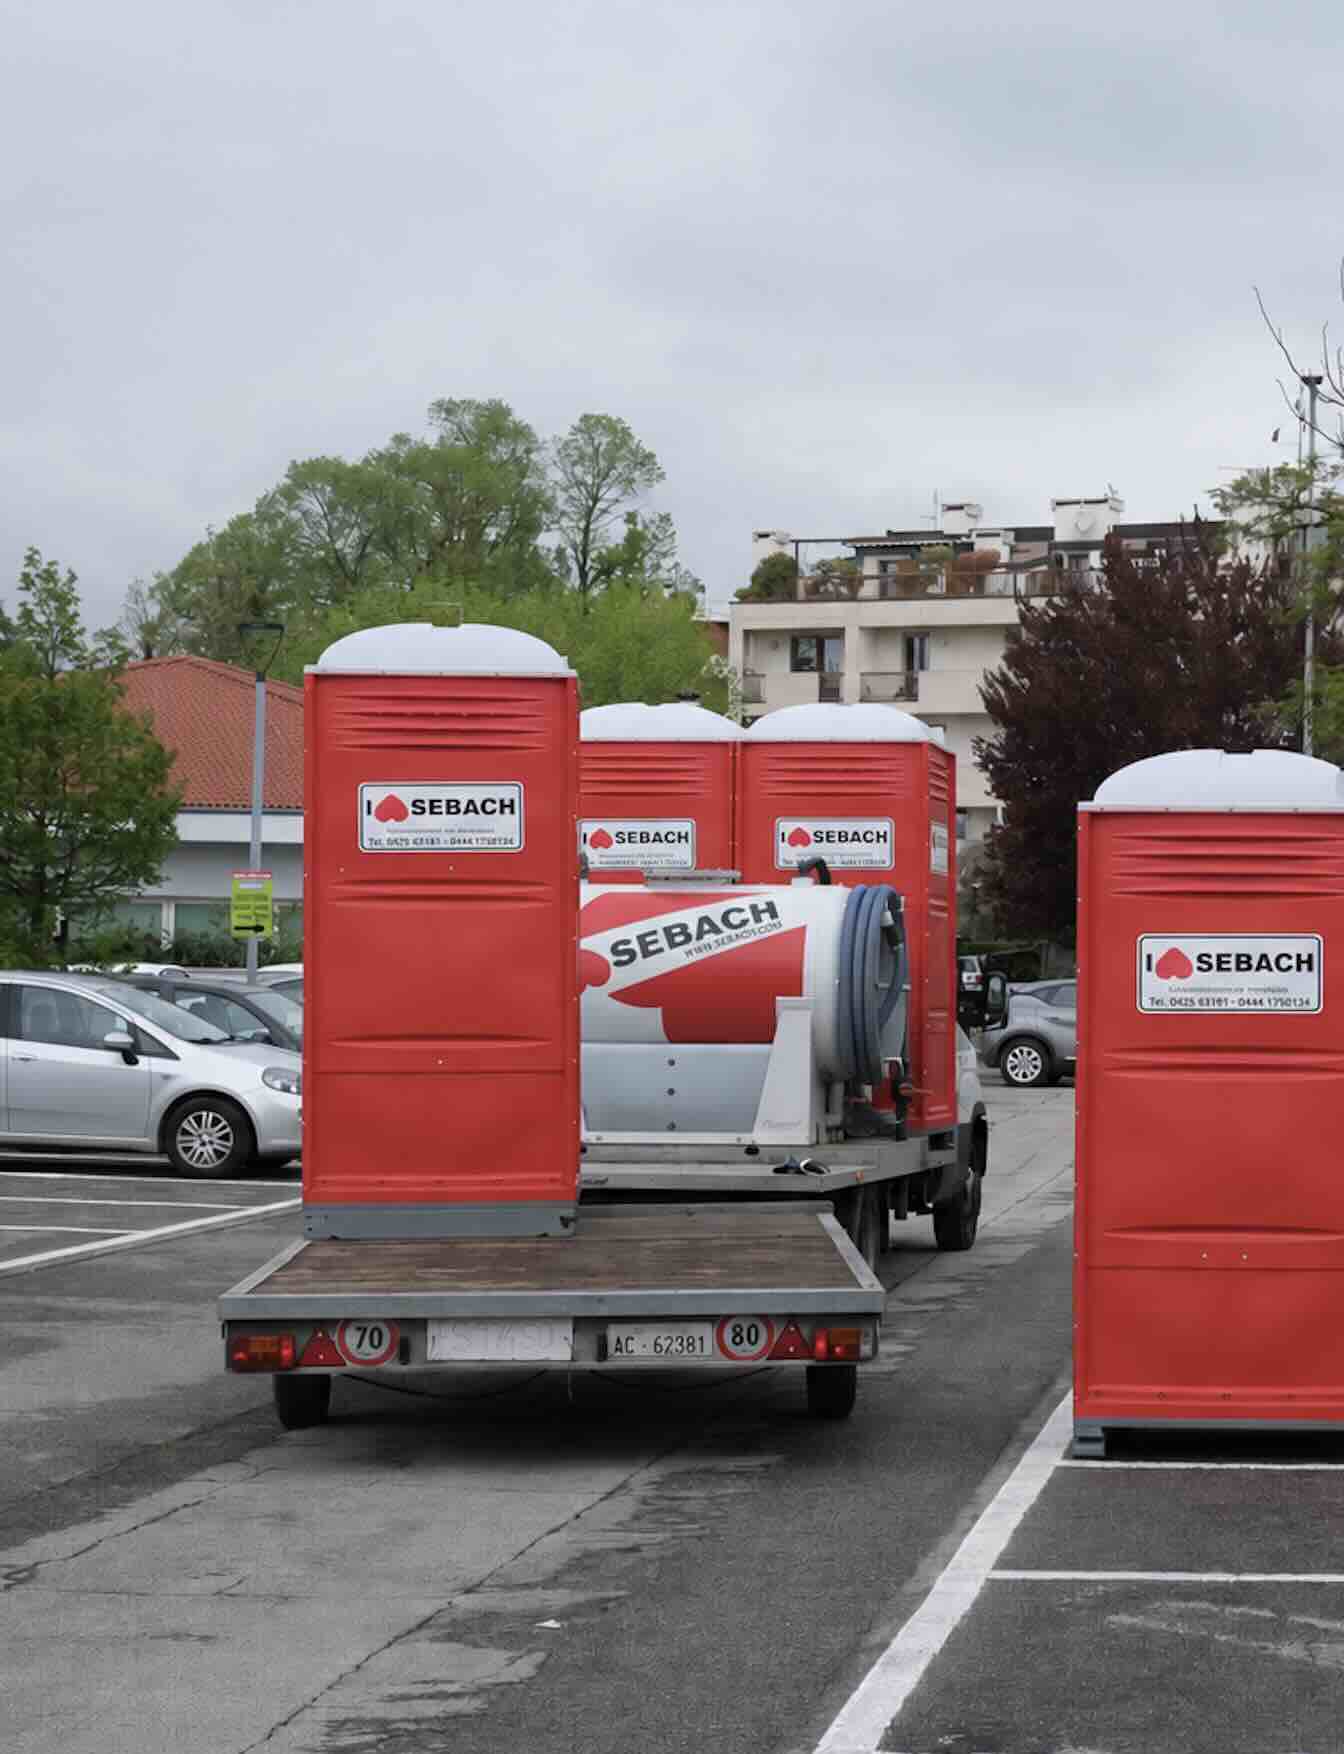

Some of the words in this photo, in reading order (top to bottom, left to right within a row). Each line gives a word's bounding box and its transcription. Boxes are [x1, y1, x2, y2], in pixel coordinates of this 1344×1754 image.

[366, 800, 372, 816] I
[411, 798, 515, 816] SEBACH
[583, 832, 587, 844] I
[615, 831, 689, 844] SEBACH
[781, 831, 785, 843] I
[813, 830, 888, 843] SEBACH
[610, 900, 780, 968] SEBACH
[1146, 953, 1153, 972] I
[1196, 953, 1314, 972] SEBACH
[355, 1326, 383, 1350] 70
[614, 1335, 635, 1354] AC
[653, 1335, 705, 1354] 62381
[731, 1323, 759, 1347] 80
